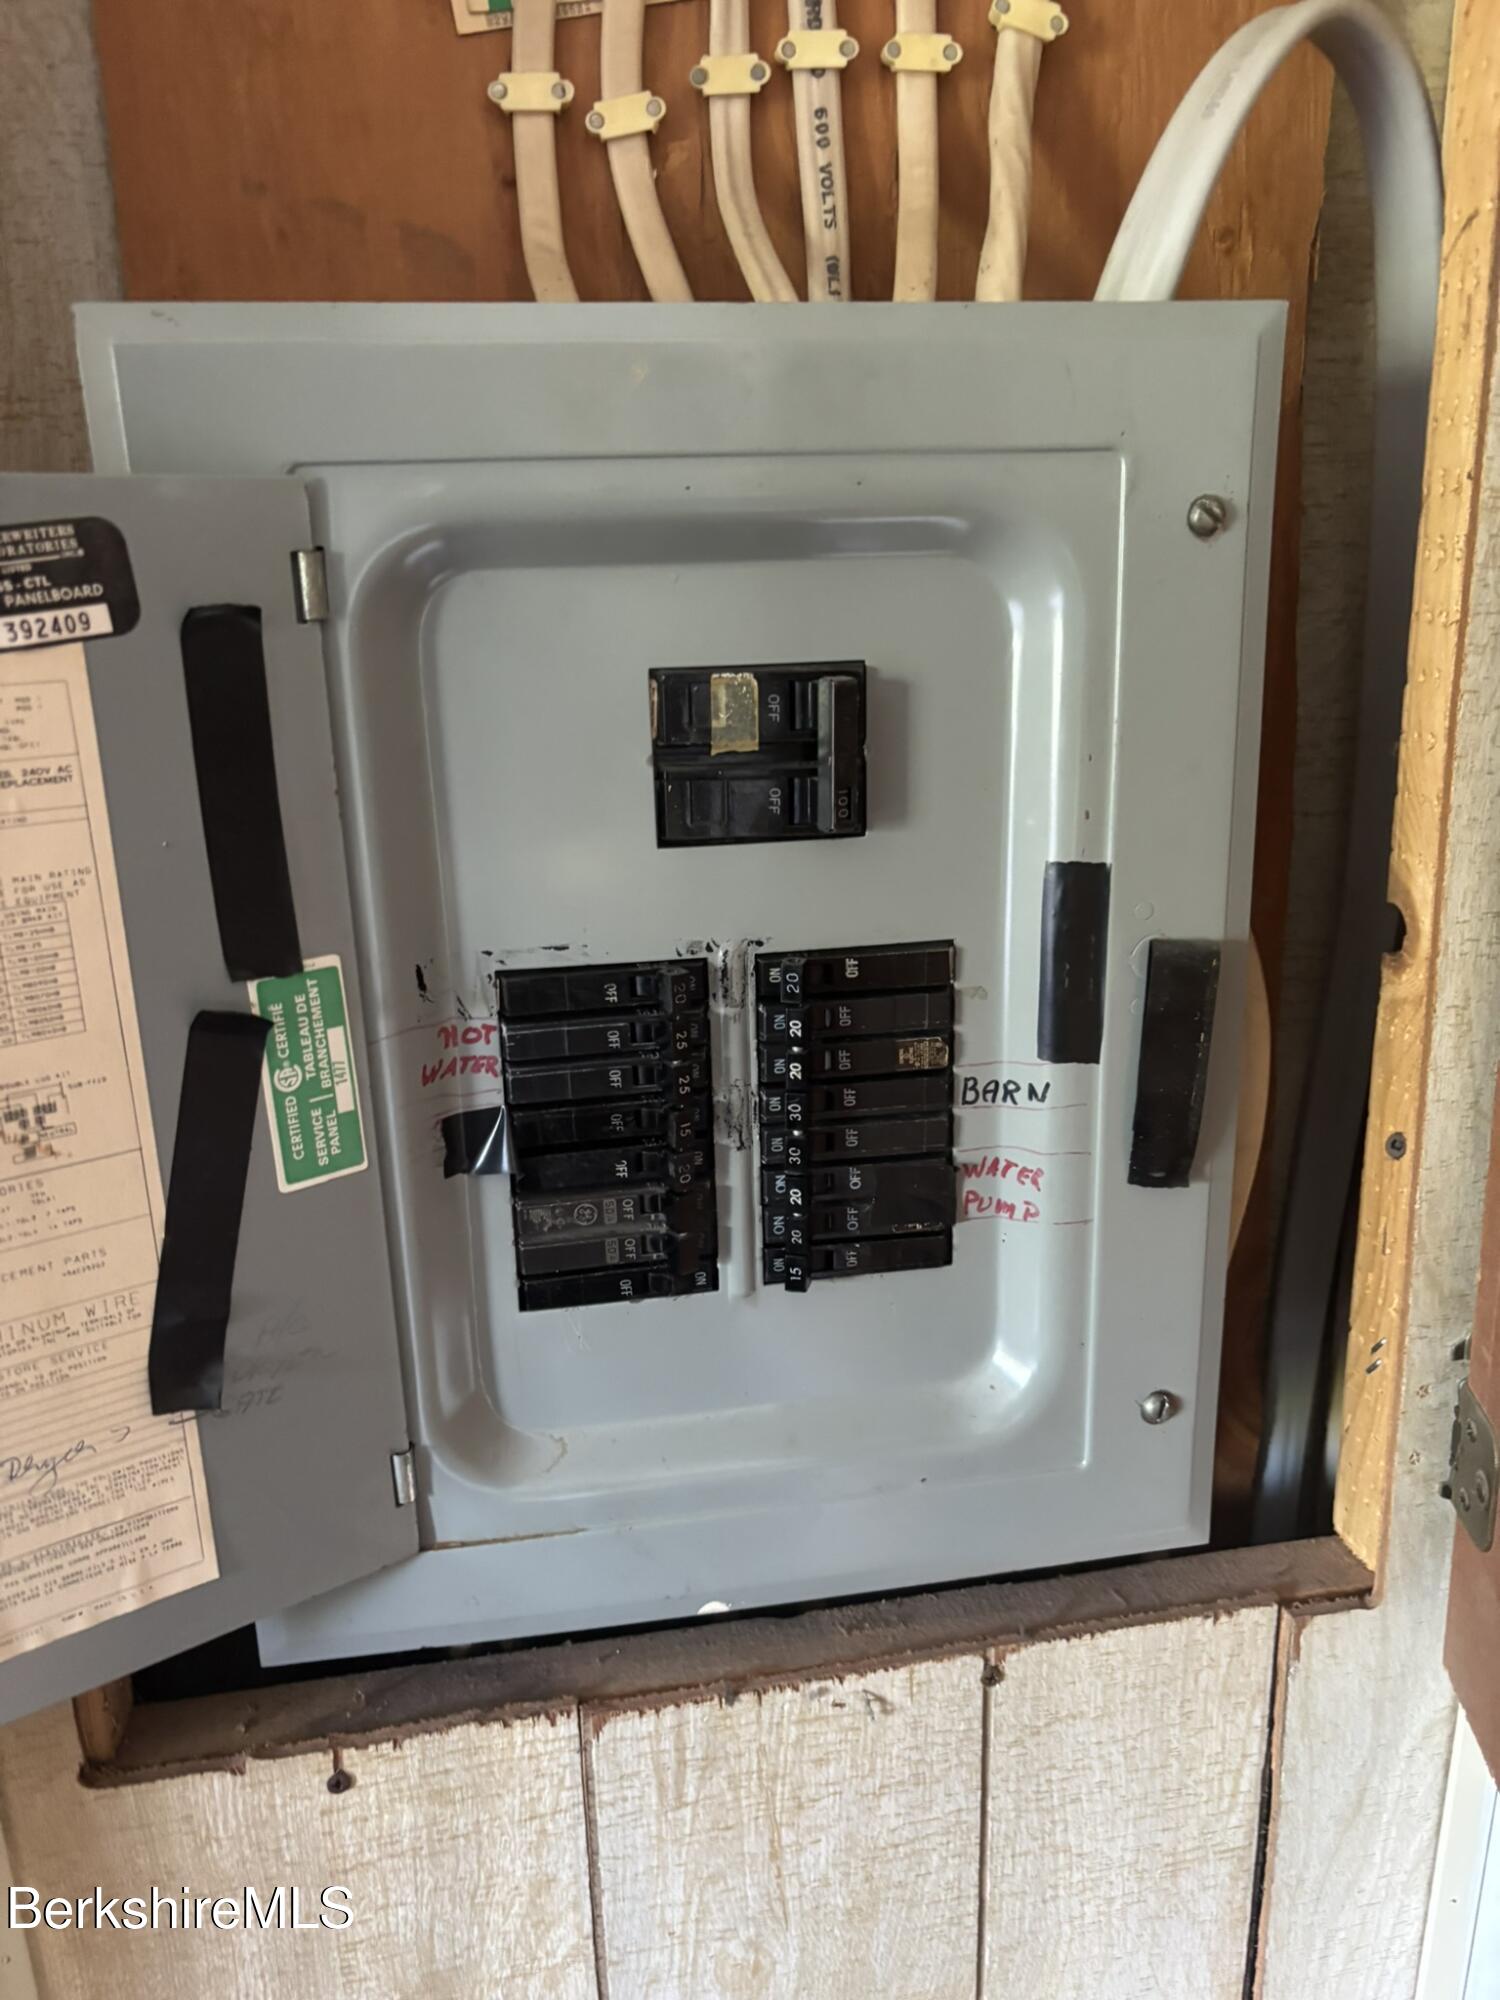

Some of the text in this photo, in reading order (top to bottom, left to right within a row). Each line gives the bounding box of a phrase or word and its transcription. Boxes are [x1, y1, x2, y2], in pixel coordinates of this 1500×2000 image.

[814, 107, 830, 149] 600
[819, 163, 837, 230] VOLTS
[4, 583, 104, 608] PANELBOARD
[3, 611, 91, 643] 392409
[768, 694, 781, 723] OFF
[768, 787, 781, 815] OFF
[838, 789, 849, 818] 100
[769, 968, 781, 983] ON
[845, 958, 859, 978] OFF
[786, 972, 800, 993] 20
[604, 983, 618, 1003] OFF
[674, 983, 687, 1004] 20
[774, 1014, 786, 1030] ON
[839, 1005, 852, 1027] OFF
[267, 1002, 290, 1059] CERTIFIÉ
[294, 993, 318, 1081] TABLEAU DE
[306, 978, 332, 1089] BRANCHEMENT
[437, 1023, 497, 1050] HOT
[789, 1019, 802, 1037] 20
[607, 1030, 620, 1049] OFF
[676, 1031, 688, 1050] 25
[774, 1058, 786, 1074] ON
[839, 1050, 852, 1070] OFF
[421, 1055, 499, 1087] WATER
[609, 1069, 622, 1088] OFF
[789, 1063, 802, 1080] 20
[679, 1075, 690, 1094] 25
[961, 1076, 1051, 1105] BARN
[769, 1096, 781, 1111] ON
[844, 1088, 857, 1107] OFF
[788, 1103, 802, 1121] 30
[285, 1095, 305, 1161] CERTIFIED
[311, 1107, 329, 1166] SERVICE
[326, 1109, 341, 1155] PANEL
[680, 1122, 691, 1137] 15
[846, 1128, 858, 1147] OFF
[771, 1137, 783, 1152] ON
[789, 1147, 801, 1165] 30
[678, 1165, 691, 1184] 20
[775, 1175, 786, 1193] ON
[849, 1167, 861, 1190] OFF
[962, 1156, 1045, 1192] WATER
[790, 1189, 802, 1205] 20
[963, 1189, 1040, 1222] PUMP
[622, 1198, 634, 1221] OFF
[847, 1207, 859, 1231] OFF
[773, 1215, 785, 1235] ON
[791, 1229, 802, 1245] 20
[63, 1247, 108, 1266] PARTS
[624, 1238, 637, 1260] OFF
[773, 1258, 785, 1272] ON
[790, 1267, 802, 1281] 15
[619, 1279, 633, 1296] OFF
[695, 1271, 706, 1286] ON
[0, 1311, 67, 1341] INUM
[85, 1291, 140, 1318] WIRE
